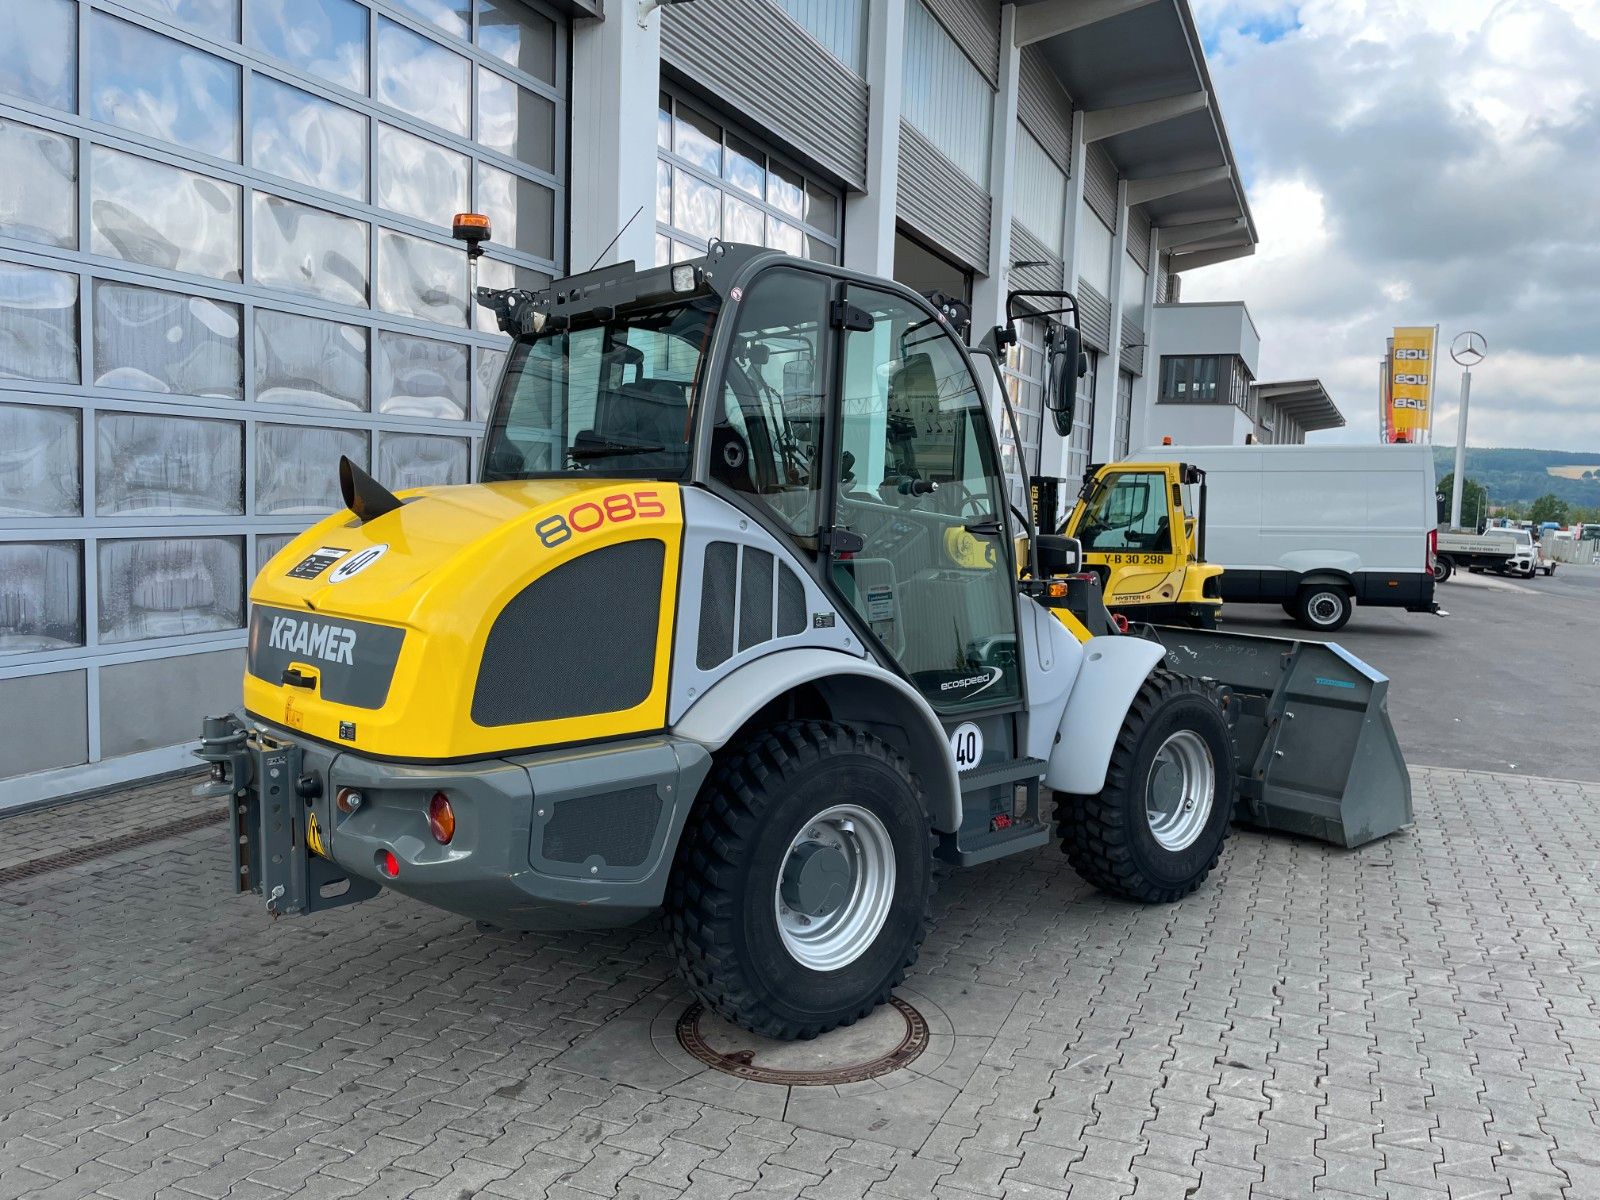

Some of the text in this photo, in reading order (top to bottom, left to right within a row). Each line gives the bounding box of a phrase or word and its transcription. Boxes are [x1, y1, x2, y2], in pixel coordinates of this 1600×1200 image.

[535, 491, 665, 548] 8085
[338, 550, 381, 575] 40
[1104, 554, 1164, 564] Y-B 30 298
[268, 616, 357, 666] KRAMER
[941, 673, 990, 691] ecospeed
[956, 731, 976, 765] 40
